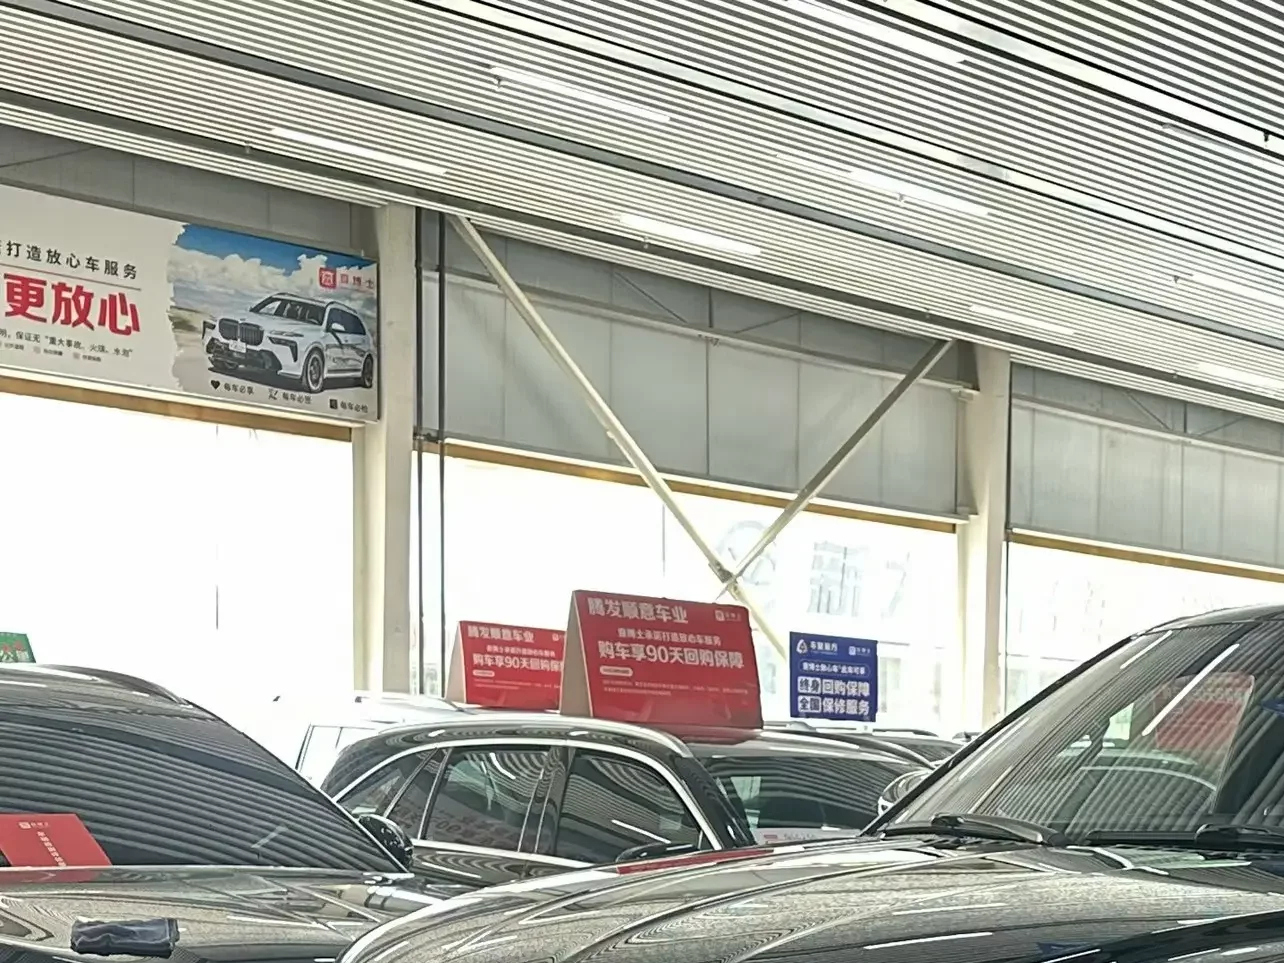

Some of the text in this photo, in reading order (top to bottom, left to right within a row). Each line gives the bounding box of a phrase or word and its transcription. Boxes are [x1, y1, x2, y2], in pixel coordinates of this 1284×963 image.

[3, 272, 141, 336] 更放心
[598, 641, 745, 669] 购车享90天回购保障
